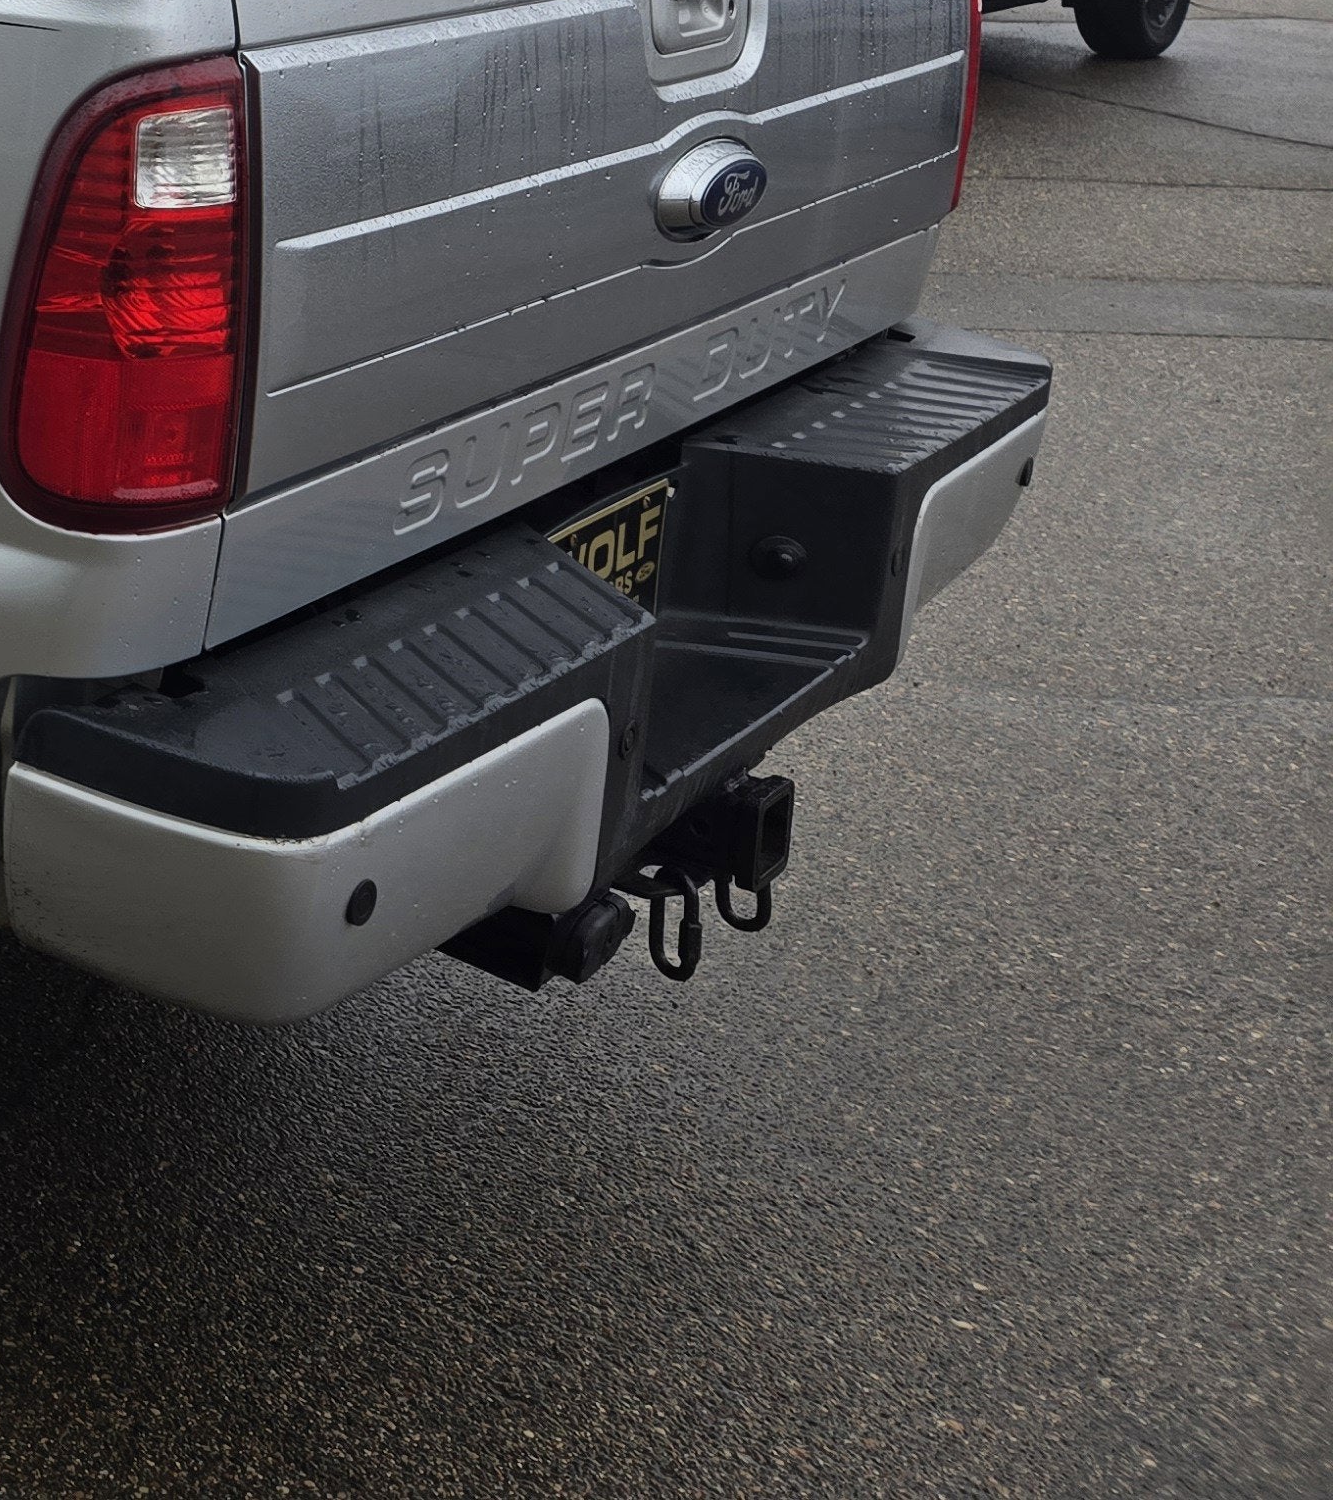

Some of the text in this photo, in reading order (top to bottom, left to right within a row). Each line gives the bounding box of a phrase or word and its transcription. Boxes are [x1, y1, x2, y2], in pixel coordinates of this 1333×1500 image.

[717, 169, 760, 217] Ford
[393, 278, 849, 537] SUPER DUTY
